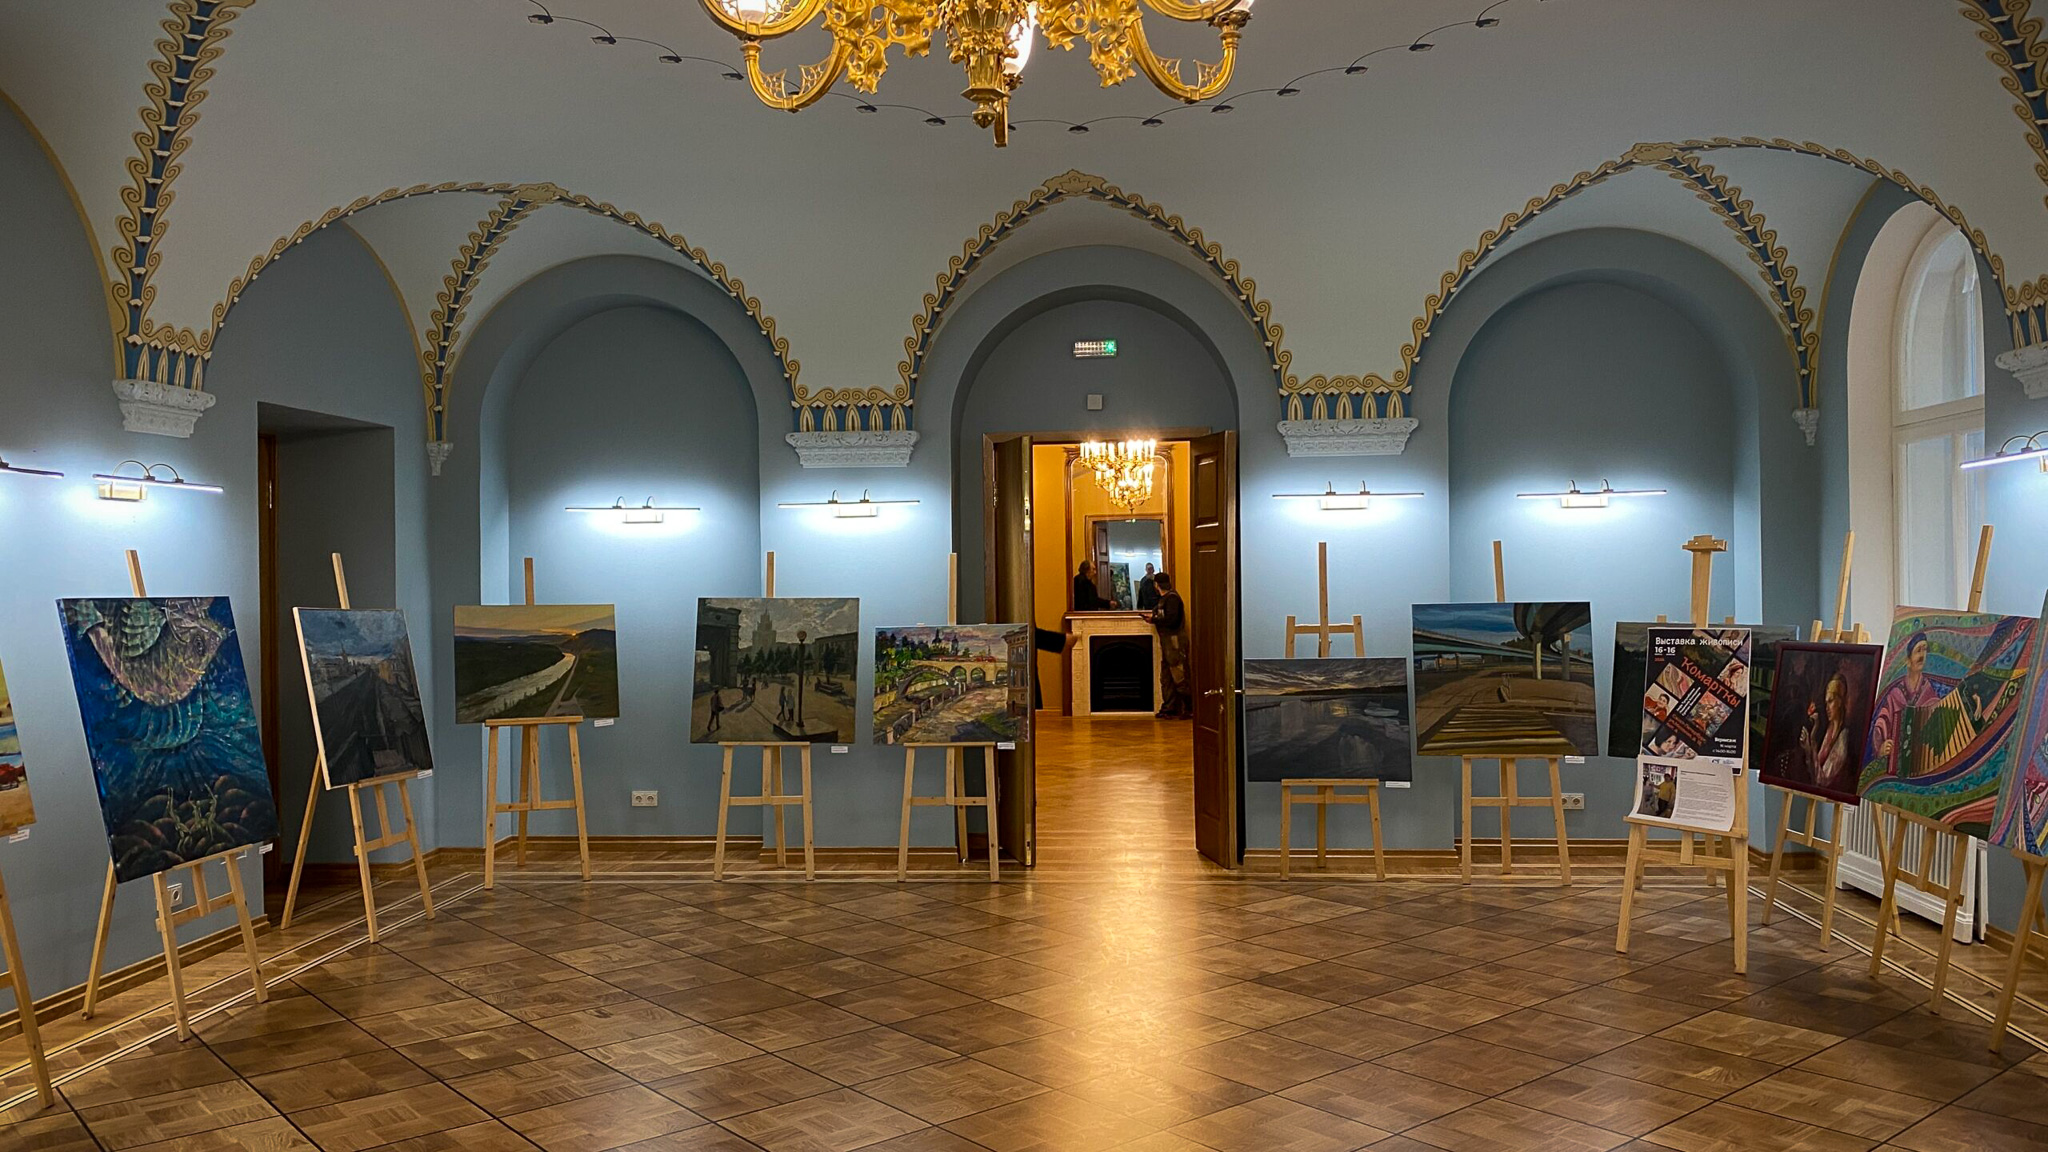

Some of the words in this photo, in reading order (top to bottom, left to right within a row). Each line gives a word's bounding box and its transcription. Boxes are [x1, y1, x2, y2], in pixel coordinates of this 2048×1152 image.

[1655, 636, 1696, 646] Выставка
[1699, 638, 1743, 646] живописи
[1681, 656, 1741, 707] Комарткы
